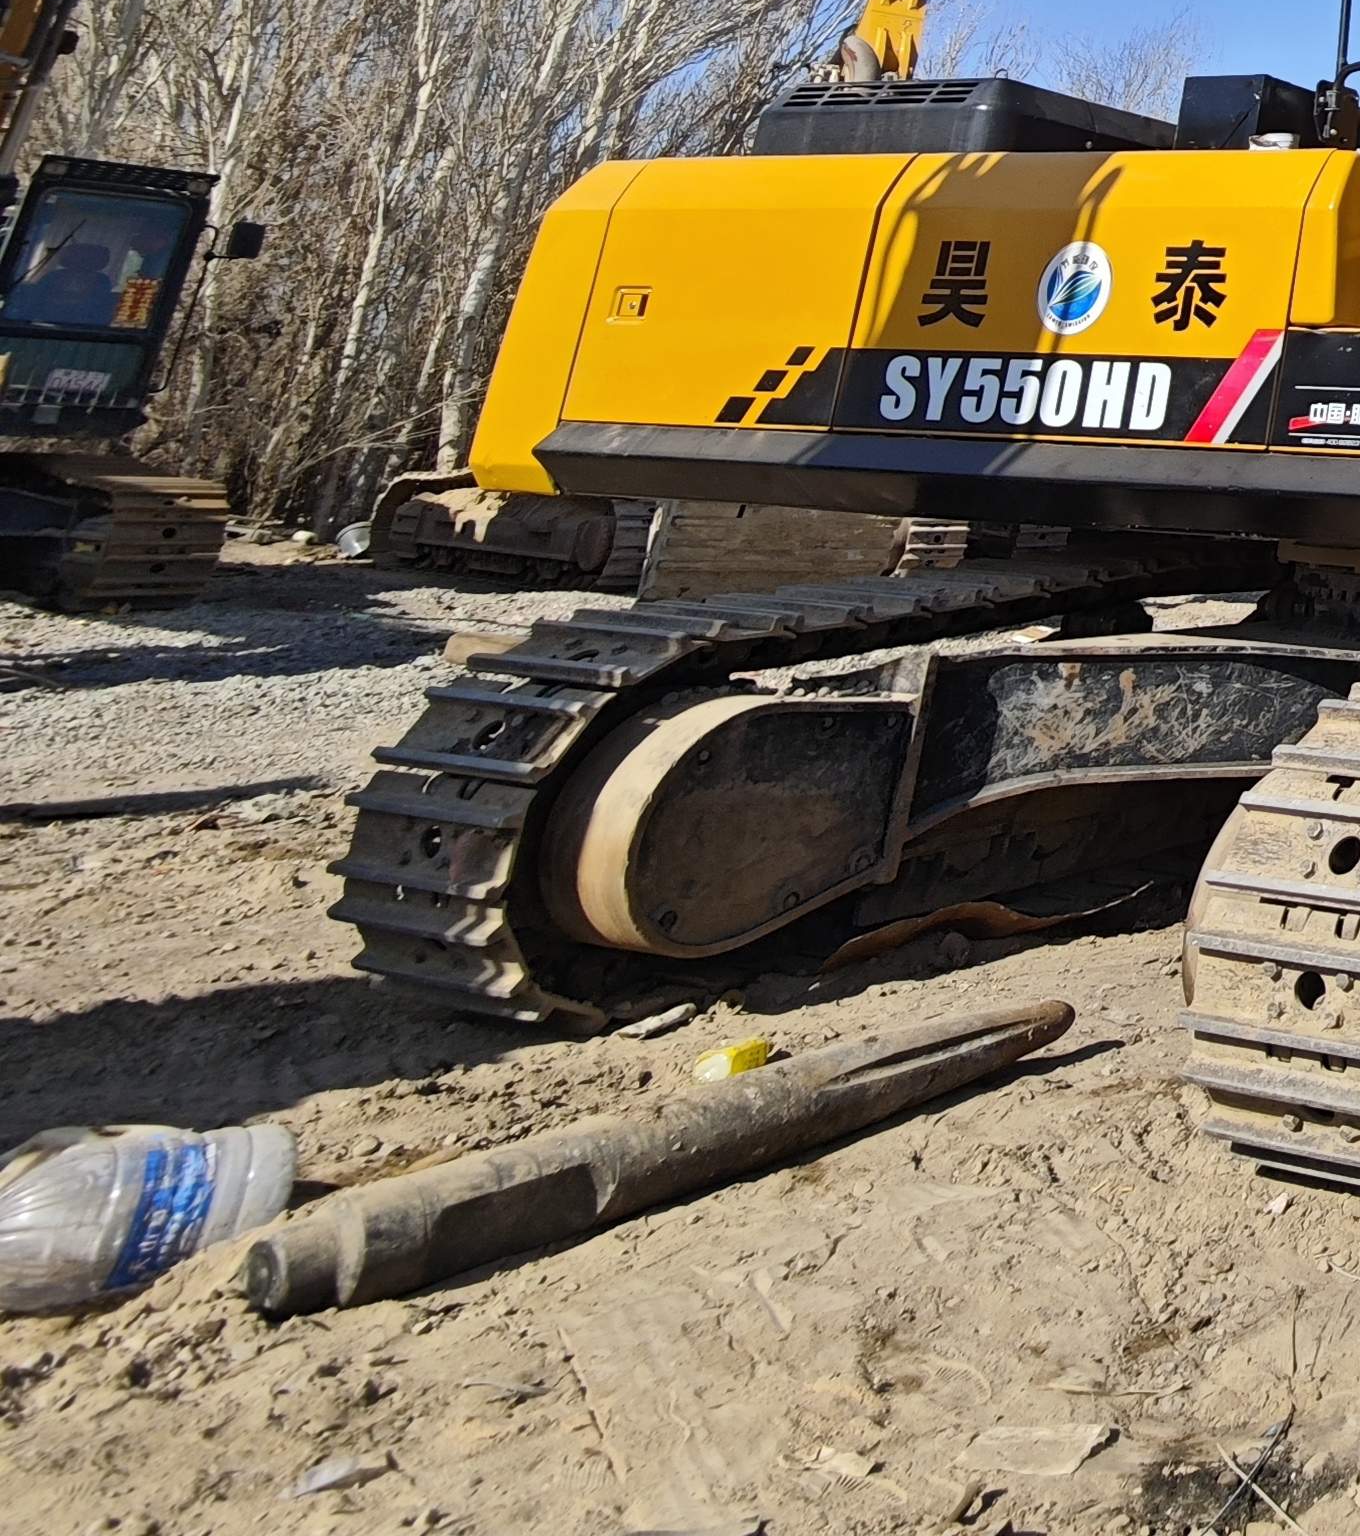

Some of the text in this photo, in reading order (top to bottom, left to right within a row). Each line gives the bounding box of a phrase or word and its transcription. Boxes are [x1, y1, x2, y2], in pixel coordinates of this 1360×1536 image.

[918, 239, 1227, 332] 昊 泰
[879, 354, 1172, 431] SY550HD
